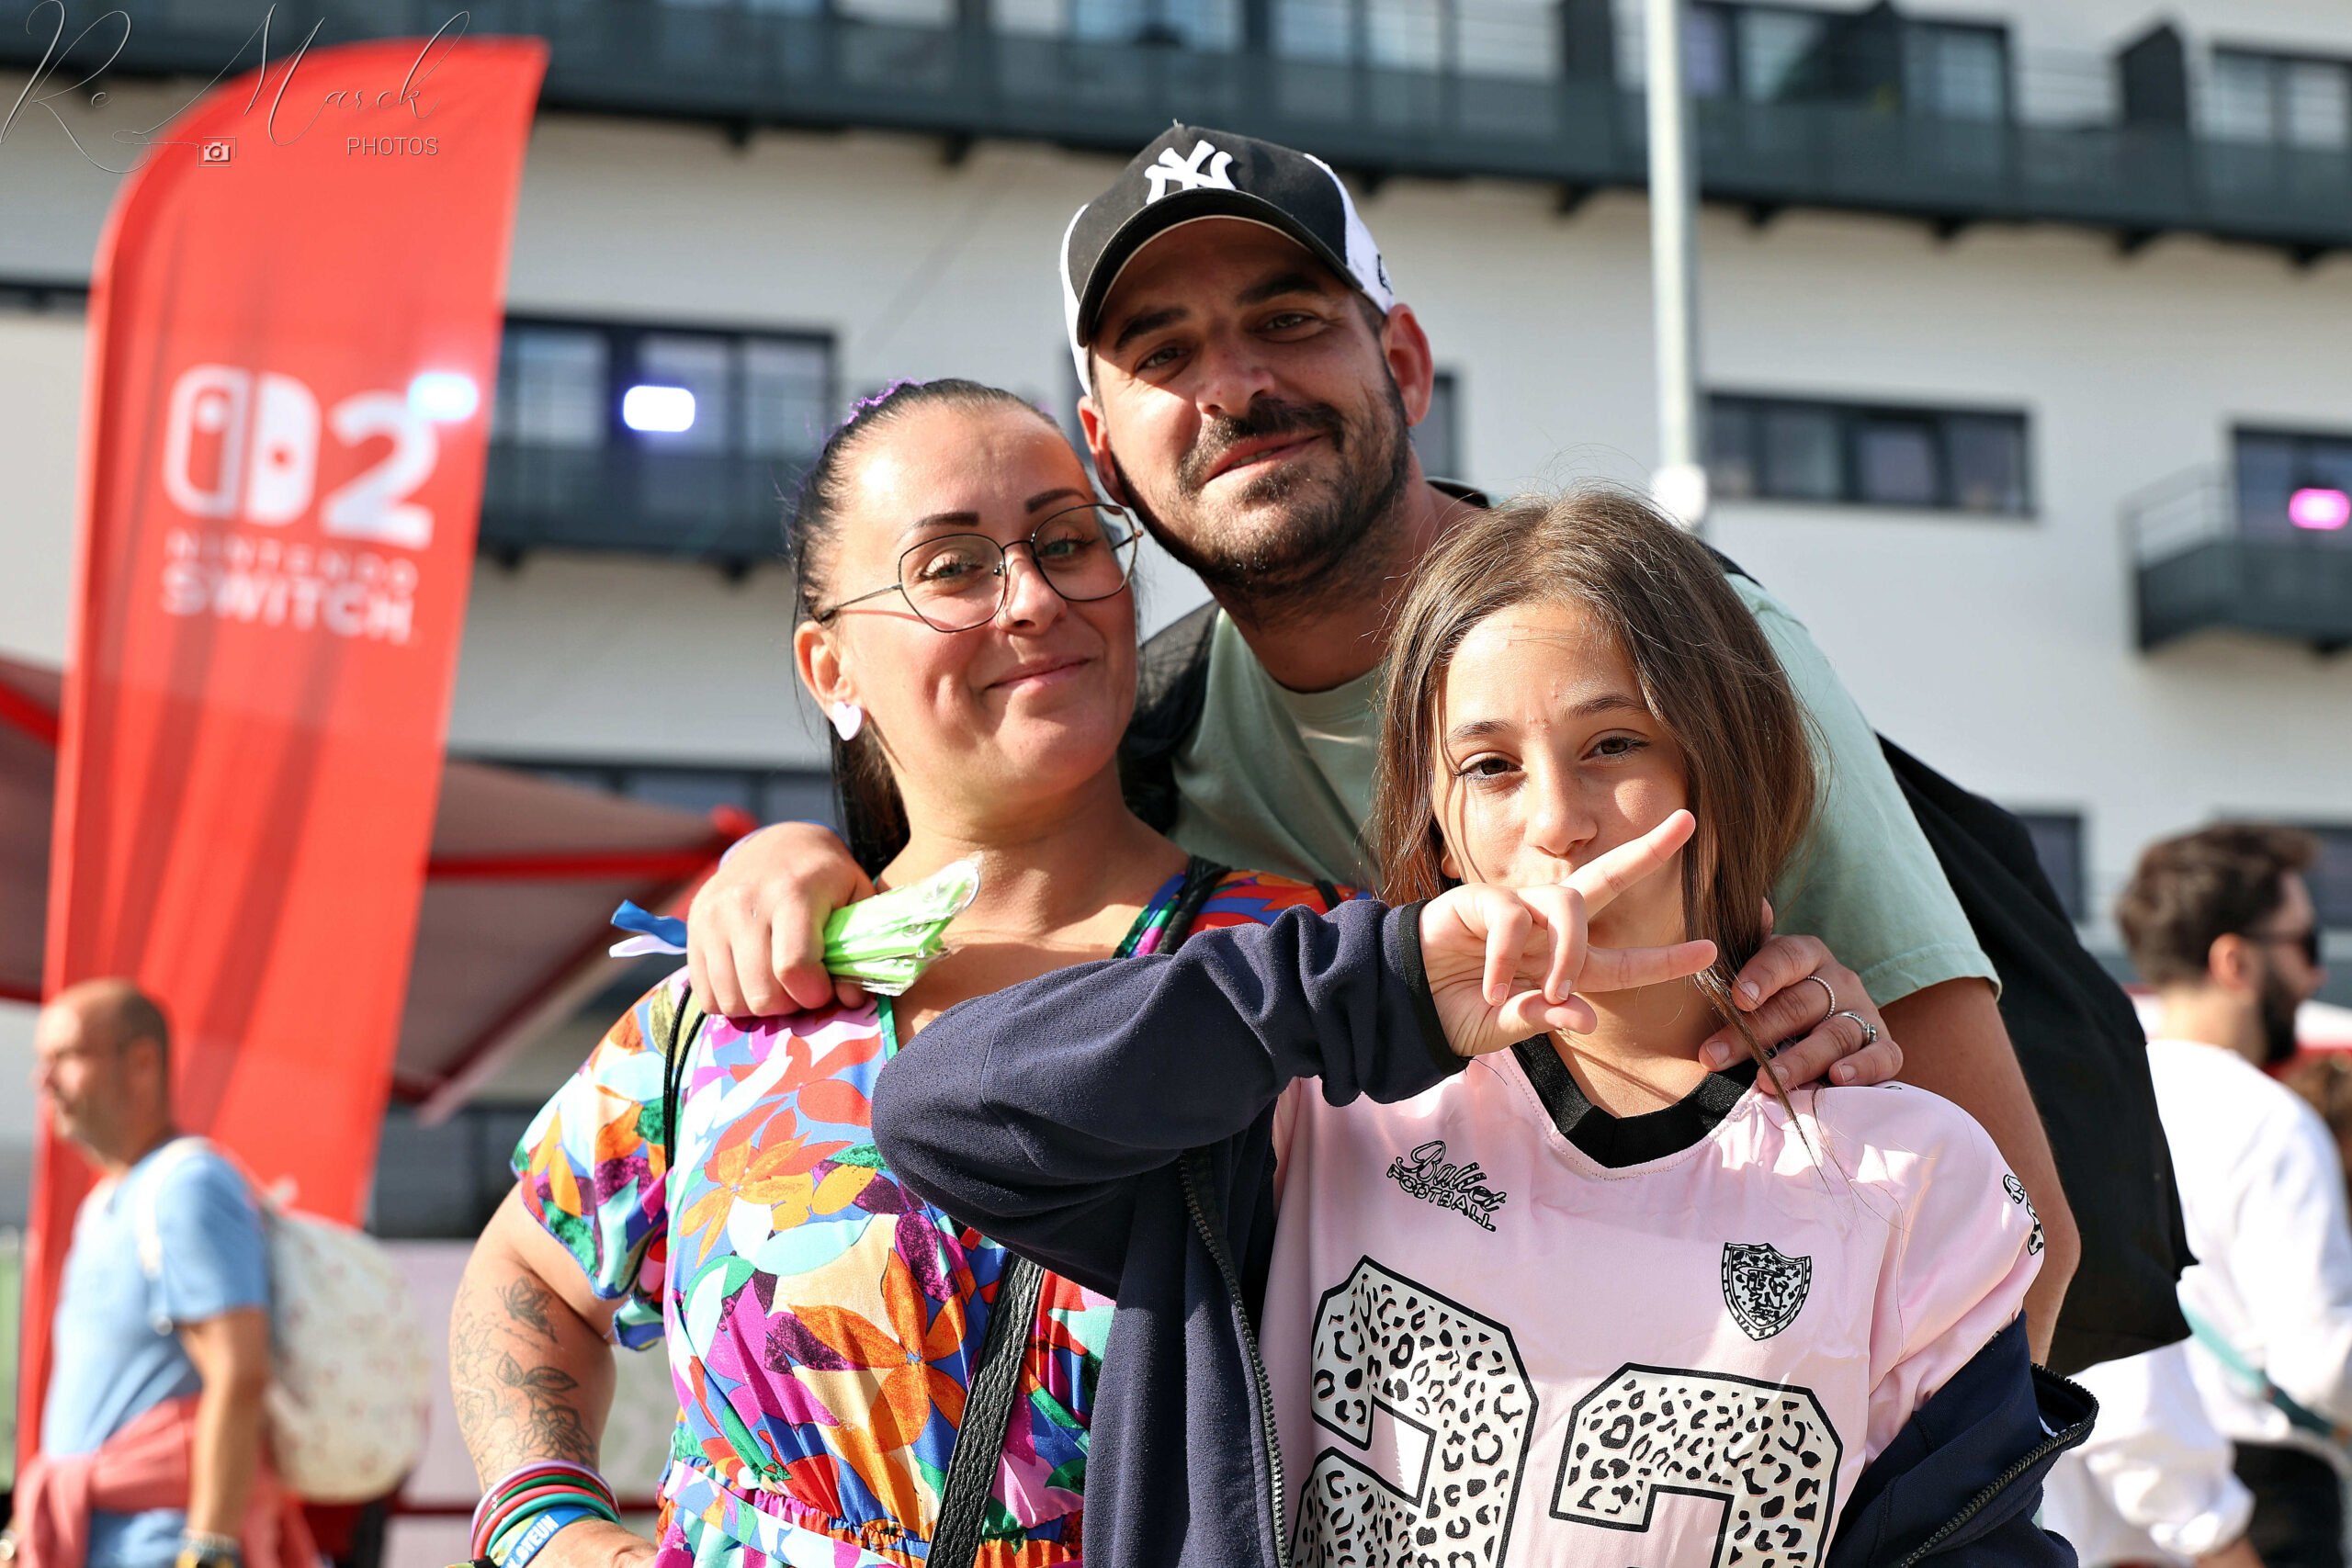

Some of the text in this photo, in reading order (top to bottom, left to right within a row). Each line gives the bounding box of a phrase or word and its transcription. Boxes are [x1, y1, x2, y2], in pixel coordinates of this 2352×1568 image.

[1144, 140, 1237, 205] NY
[323, 389, 440, 549] 2
[161, 562, 416, 646] SWITCH
[1385, 1163, 1497, 1232] FOOTBALL
[1396, 1140, 1507, 1212] Ballet
[515, 1514, 560, 1562] STEUN
